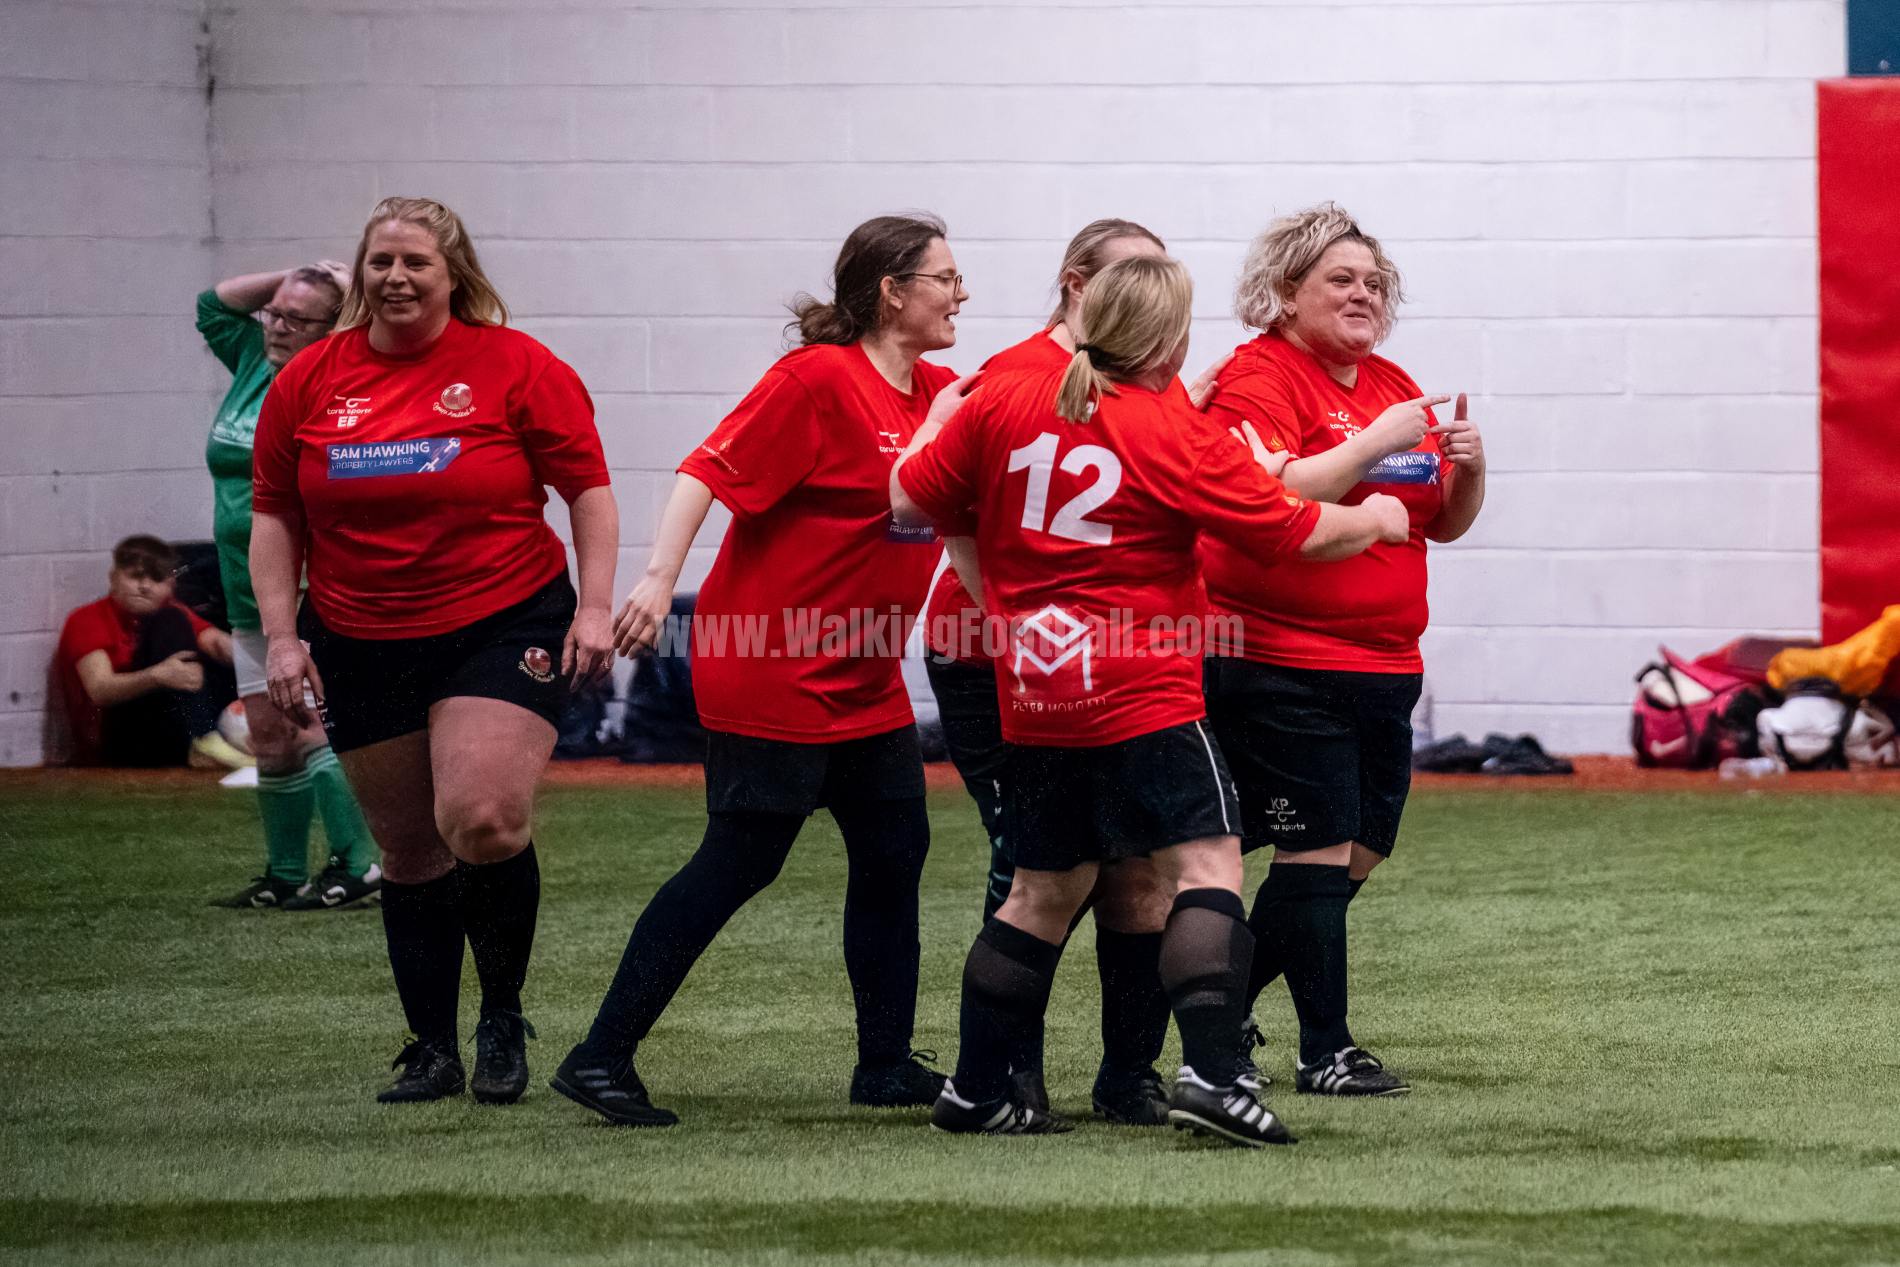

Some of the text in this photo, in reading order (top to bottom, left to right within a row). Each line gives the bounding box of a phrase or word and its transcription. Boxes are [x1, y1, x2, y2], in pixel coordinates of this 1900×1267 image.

[337, 415, 358, 427] EE
[331, 442, 430, 460] SAM HAWKING
[374, 457, 414, 467] LAWYERS
[1383, 454, 1430, 466] HAWKING
[1008, 431, 1122, 545] 12
[1270, 797, 1289, 810] KP
